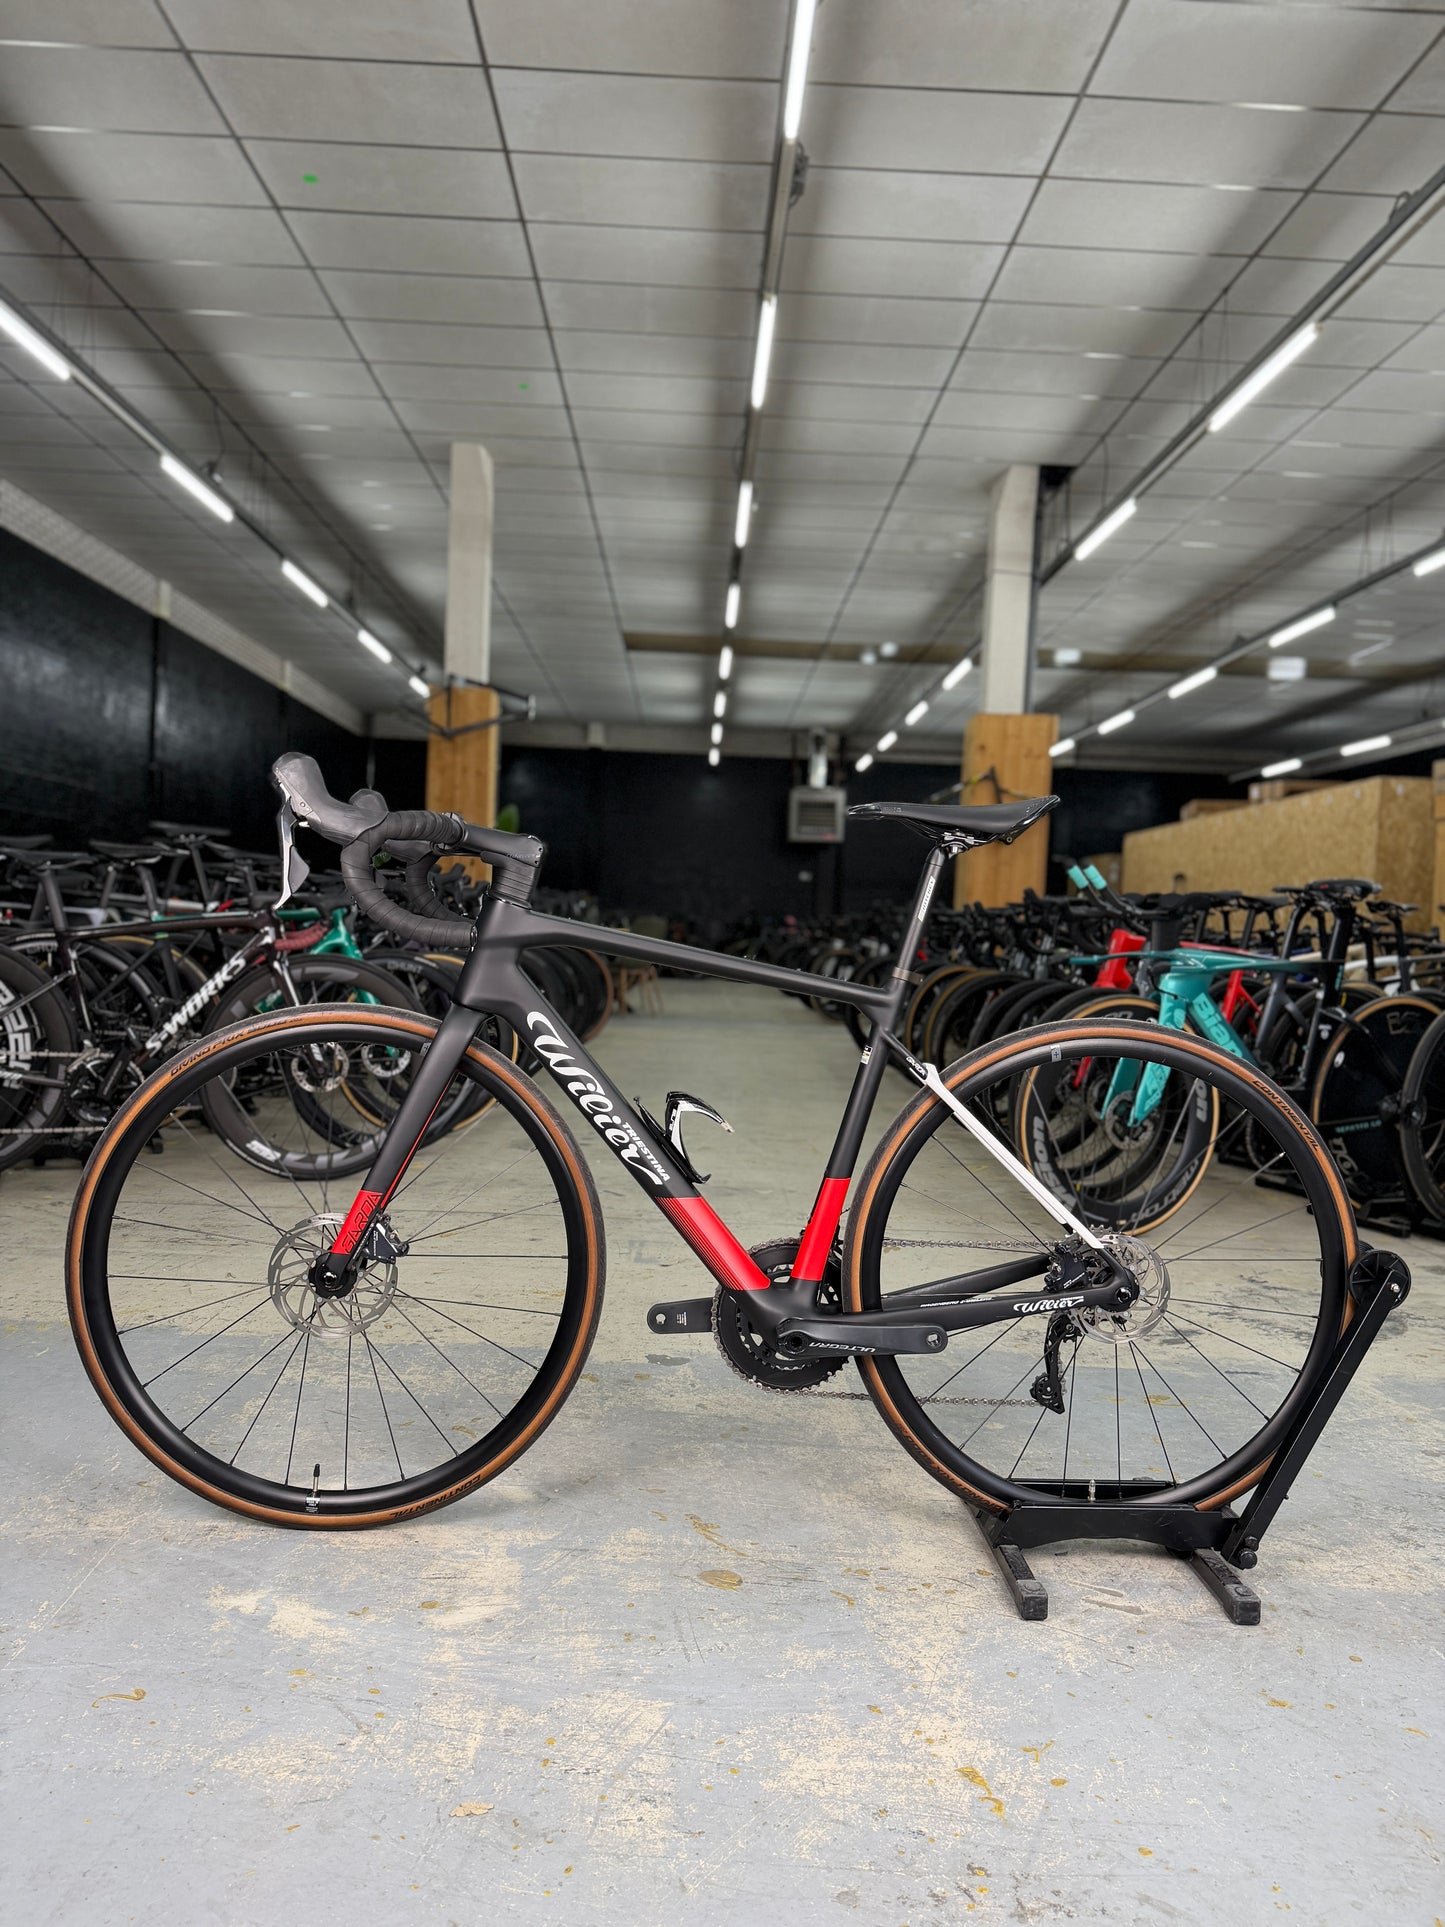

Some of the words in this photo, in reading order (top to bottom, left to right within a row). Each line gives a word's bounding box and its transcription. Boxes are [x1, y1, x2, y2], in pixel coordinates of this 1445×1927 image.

[146, 957, 247, 1058] S-WORKS
[170, 1046, 211, 1077] GRAND
[212, 1032, 244, 1049] PRIX
[526, 1011, 663, 1186] Wilier
[1252, 1080, 1319, 1152] CONTINENTAL
[622, 1121, 671, 1182] TRIESTINA
[341, 1194, 383, 1254] GARDA
[1013, 1299, 1084, 1314] Wilier
[809, 1342, 876, 1353] ULTEGRA
[390, 1474, 481, 1518] CONTINENTAL
